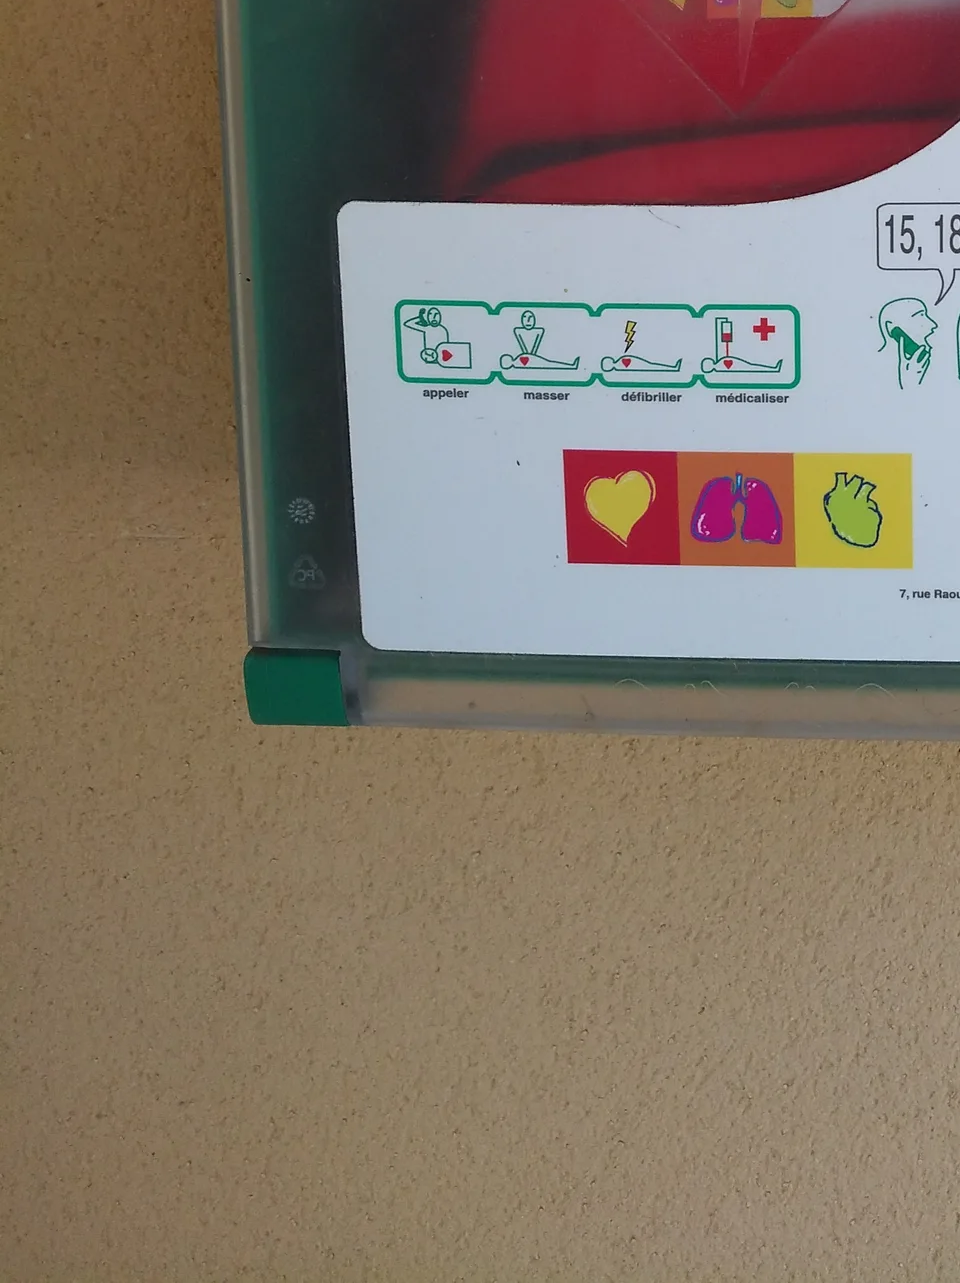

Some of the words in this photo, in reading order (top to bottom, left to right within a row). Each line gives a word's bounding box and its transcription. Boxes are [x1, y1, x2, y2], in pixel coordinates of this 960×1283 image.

[885, 213, 923, 261] 15,
[422, 388, 469, 400] appeler
[523, 391, 570, 402] masser
[621, 391, 682, 403] défibriller
[715, 392, 790, 404] médicaliser
[899, 589, 910, 601] 7,
[912, 591, 931, 600] rue
